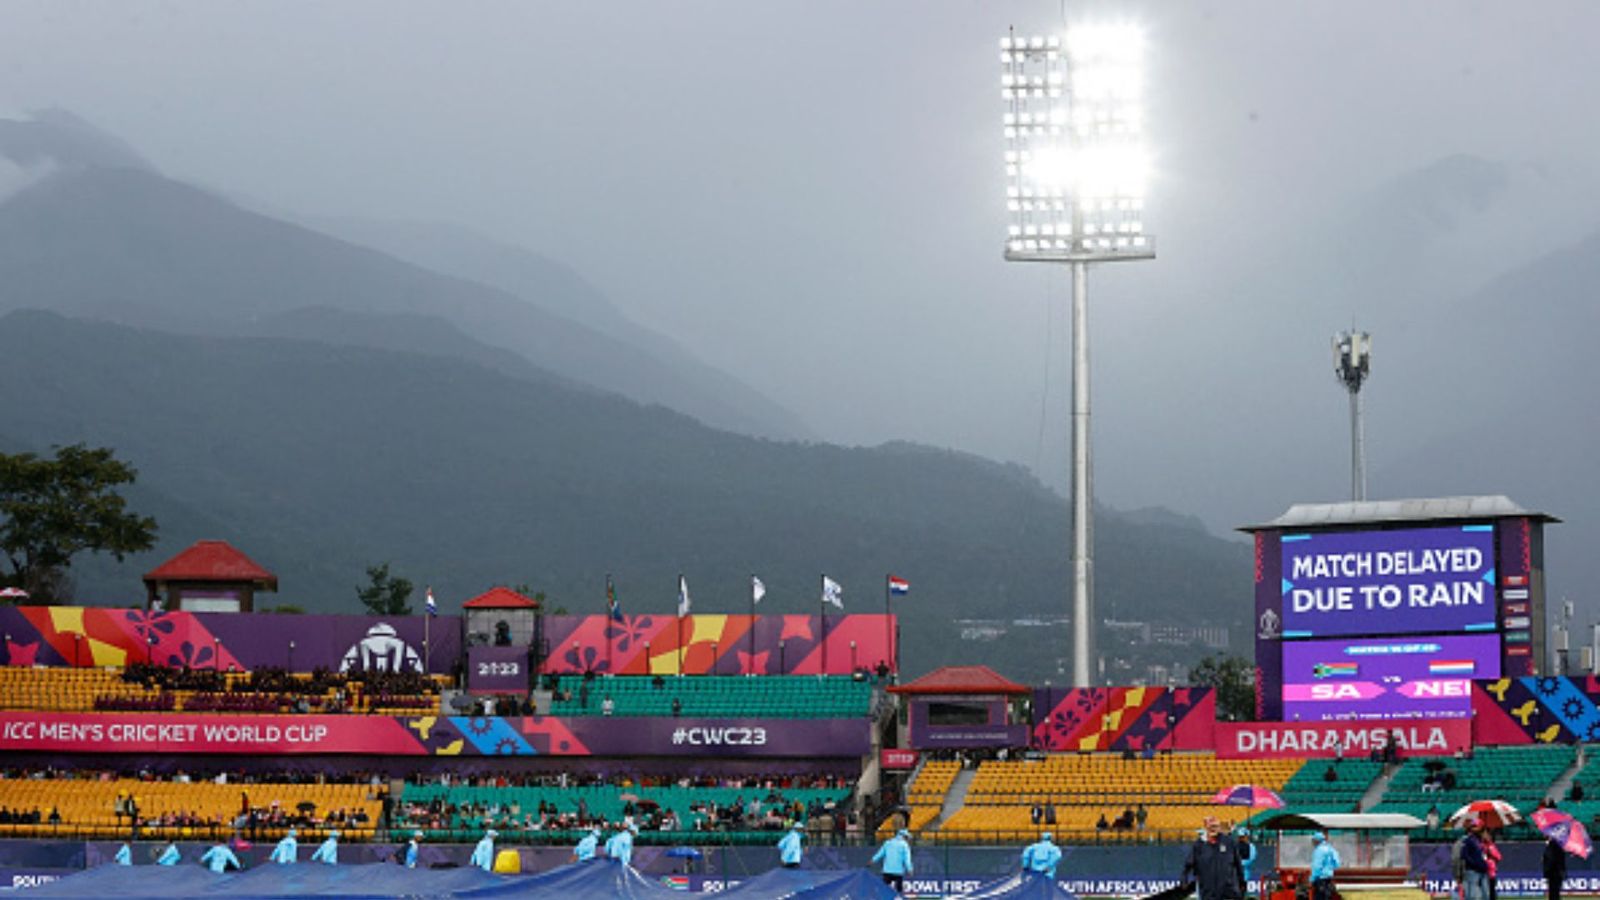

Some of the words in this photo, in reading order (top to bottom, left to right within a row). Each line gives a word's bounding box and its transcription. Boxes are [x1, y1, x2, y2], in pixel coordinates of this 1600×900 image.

[1293, 552, 1371, 580] MATCH
[1376, 547, 1483, 575] DELAYED
[1293, 586, 1354, 613] DUE
[1360, 584, 1401, 610] TO
[1408, 581, 1484, 608] RAIN
[1311, 683, 1361, 699] SA
[3, 722, 35, 740] ICC
[39, 723, 103, 741] MEN'S
[107, 724, 197, 742] CRICKET
[203, 724, 281, 743] WORLD
[285, 724, 327, 743] CUP
[672, 727, 767, 745] #CWC23
[1237, 727, 1448, 752] DHARAMSALA
[942, 880, 981, 892] FIRST
[1096, 880, 1146, 893] AFRICA
[1522, 878, 1549, 890] TOS
